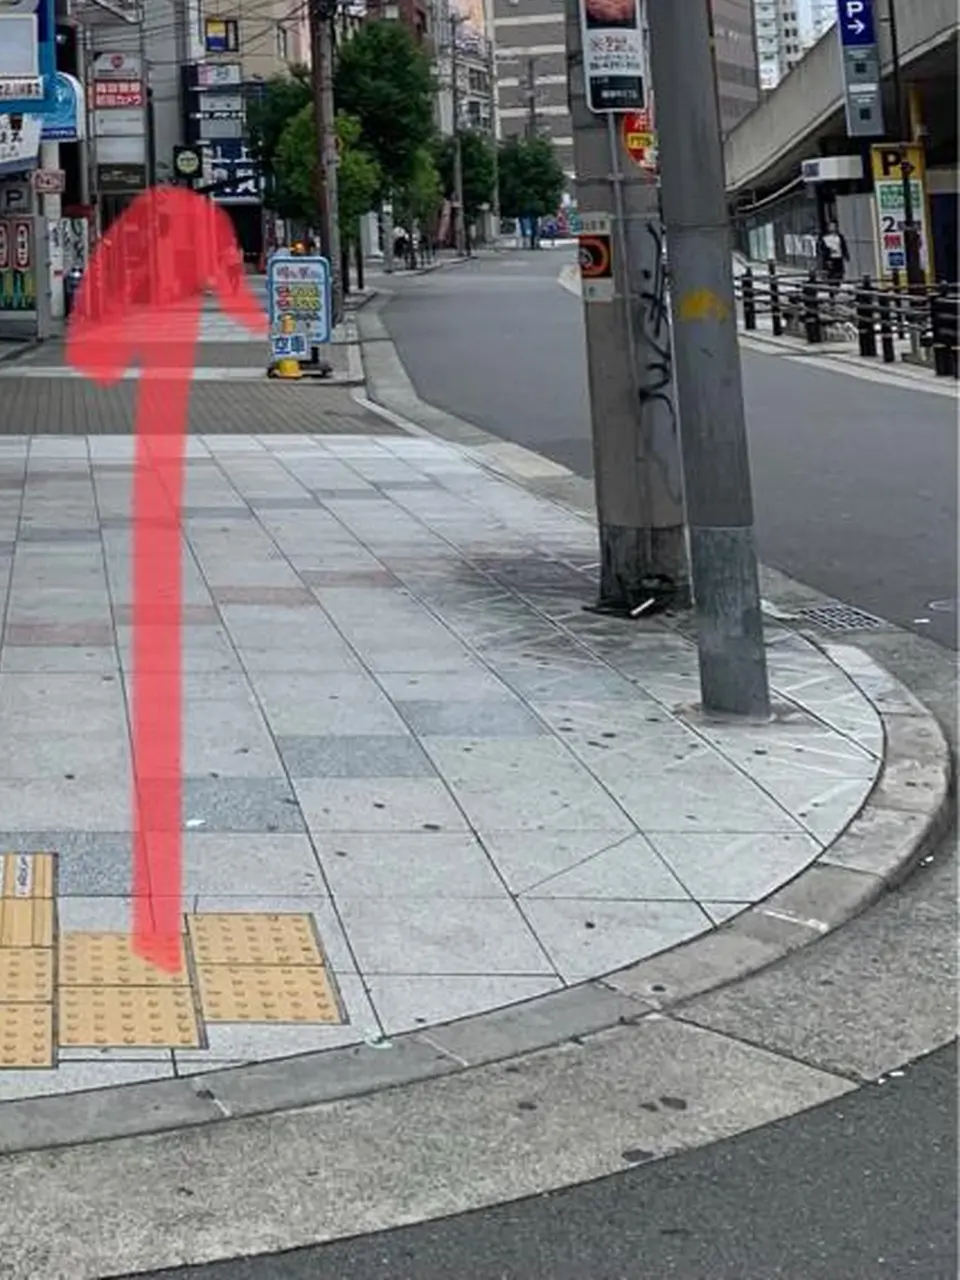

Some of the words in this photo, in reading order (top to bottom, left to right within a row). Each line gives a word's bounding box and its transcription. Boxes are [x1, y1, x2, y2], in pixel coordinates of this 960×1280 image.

[846, 1, 864, 18] P
[881, 150, 901, 176] P
[6, 190, 23, 206] P
